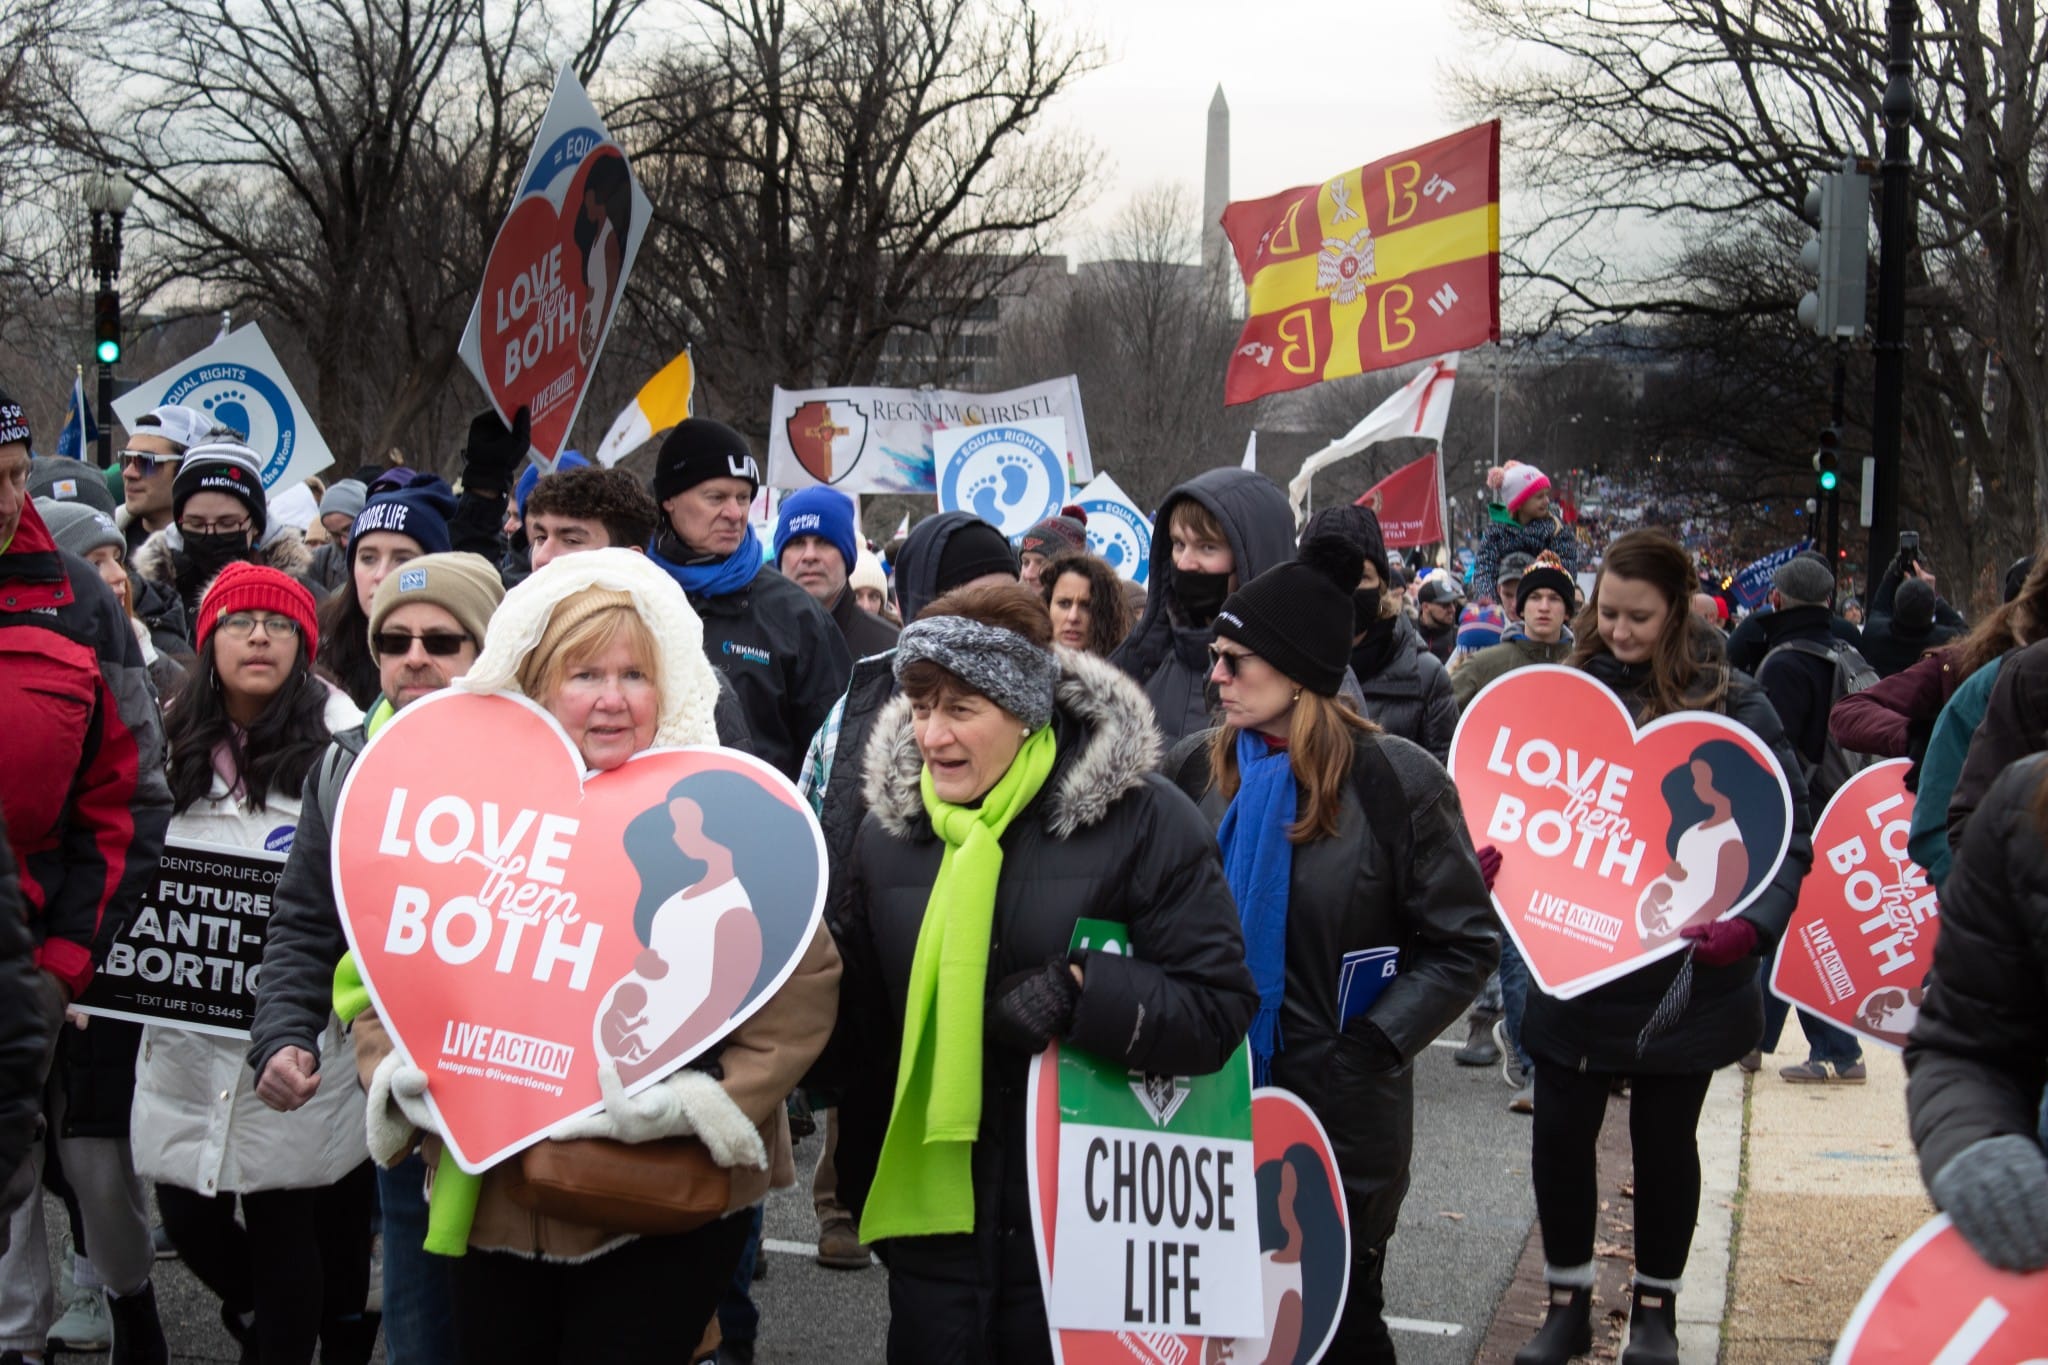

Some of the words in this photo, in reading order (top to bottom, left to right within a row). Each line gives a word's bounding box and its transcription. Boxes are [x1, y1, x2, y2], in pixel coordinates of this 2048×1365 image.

[496, 242, 562, 335] LOVE
[505, 292, 576, 388] BOTH
[168, 379, 199, 407] QUAL
[200, 367, 248, 382] RIGHTS
[531, 383, 551, 416] LIVE
[873, 399, 961, 423] REGNUM
[966, 396, 1051, 425] CHRISTI
[263, 469, 279, 485] the
[273, 429, 291, 467] Womb
[961, 431, 1001, 457] EQUAL
[1004, 430, 1047, 455] RIGHTS
[201, 476, 230, 487] MARCH
[384, 503, 409, 530] LIFE
[1105, 503, 1137, 526] EQUAL
[1133, 522, 1151, 562] RIGHTS
[731, 644, 770, 661] TEKMARK
[1487, 725, 1633, 814] LOVE
[379, 787, 580, 885] LOVE
[1546, 779, 1632, 841] them
[1486, 793, 1647, 887] BOTH
[158, 880, 271, 917] FUTURE
[455, 850, 581, 925] them
[1826, 835, 1916, 977] BOTH
[129, 906, 262, 953] ANTI-
[384, 885, 604, 991] BOTH
[1528, 889, 1568, 923] LIVE
[1566, 902, 1623, 941] ACTION
[1806, 918, 1836, 958] LIVE
[1820, 948, 1856, 1001] ACTION
[136, 994, 161, 1007] TEXT
[164, 999, 187, 1011] LIFE
[190, 1002, 206, 1013] TO
[207, 1005, 243, 1019] 53445
[441, 1020, 492, 1060] LIVE
[488, 1029, 574, 1080] ACTION
[438, 1059, 485, 1077] Instagram:
[485, 1069, 563, 1096] @liveactionorg
[1085, 1136, 1236, 1232] CHOOSE
[1124, 1239, 1202, 1326] LIFE
